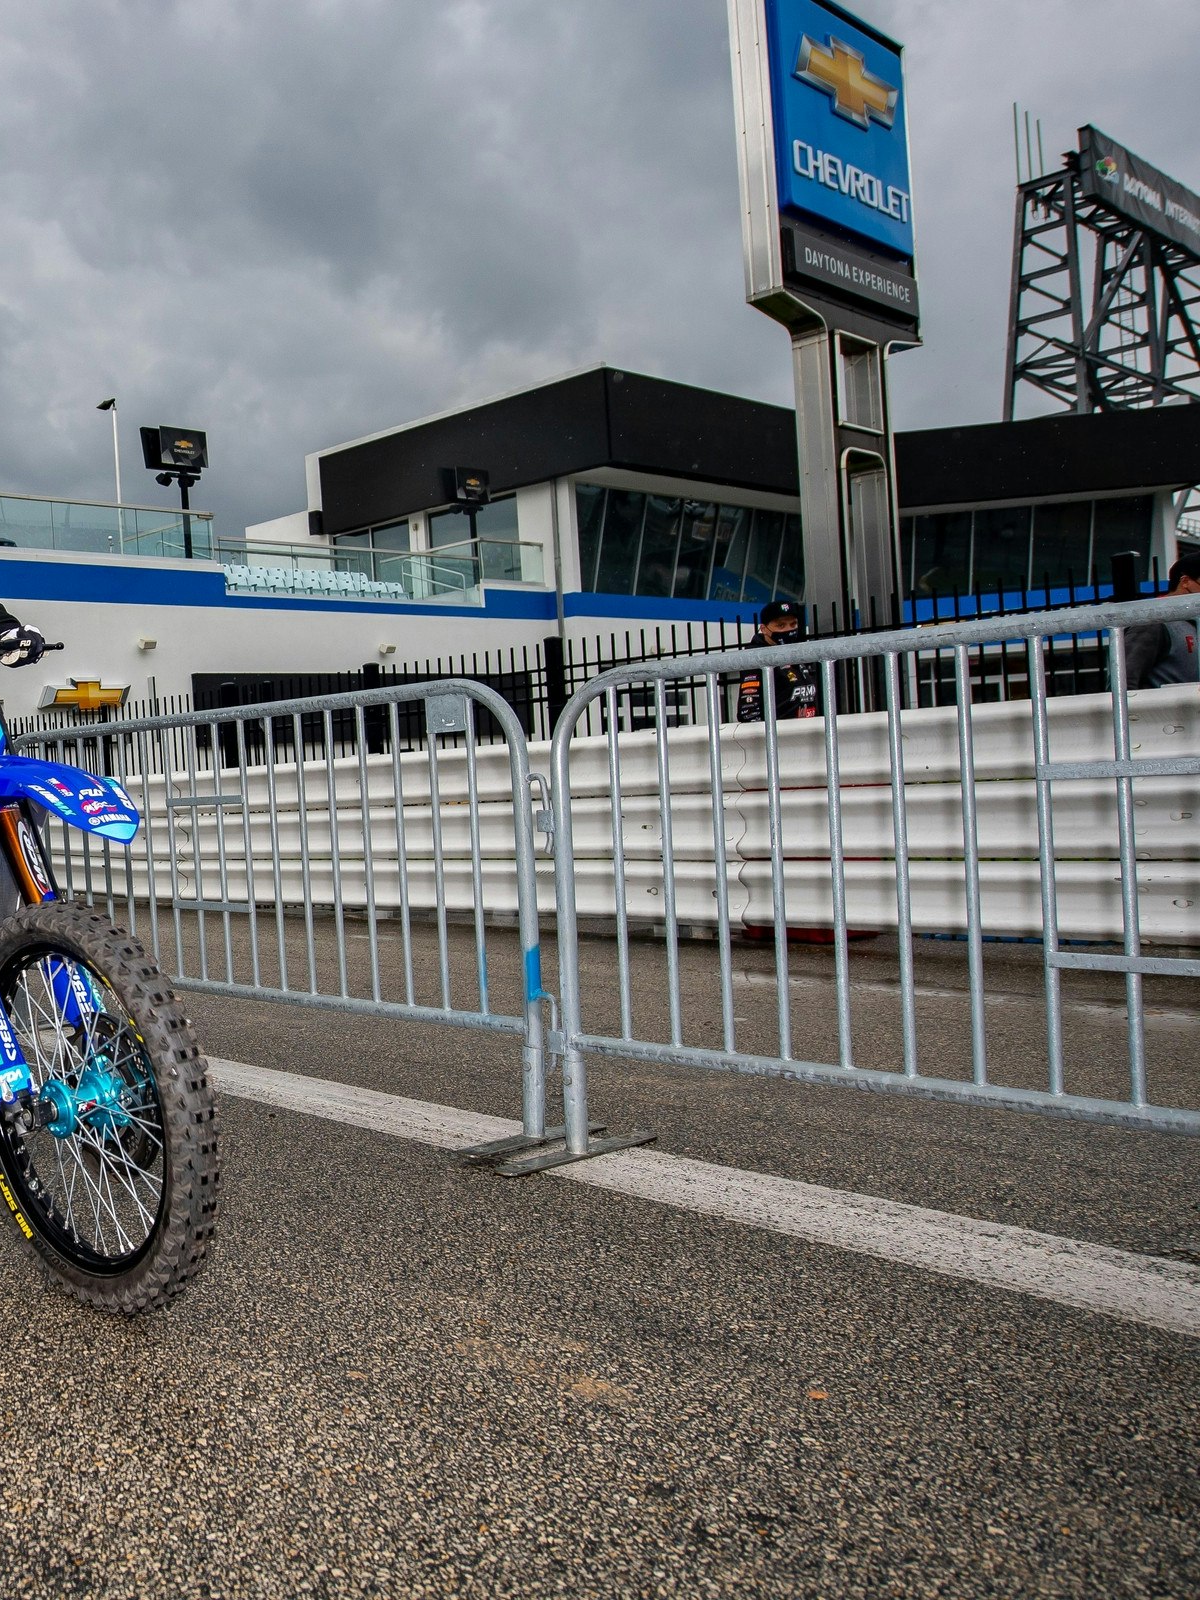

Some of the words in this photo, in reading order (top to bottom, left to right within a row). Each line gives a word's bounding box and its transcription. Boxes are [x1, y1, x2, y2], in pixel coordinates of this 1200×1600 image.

[793, 139, 909, 223] CHEVROLET
[805, 247, 850, 280] DAYTONA
[852, 267, 911, 303] EXPERIENCE
[99, 814, 132, 823] YAMAHA
[14, 1212, 34, 1239] MID
